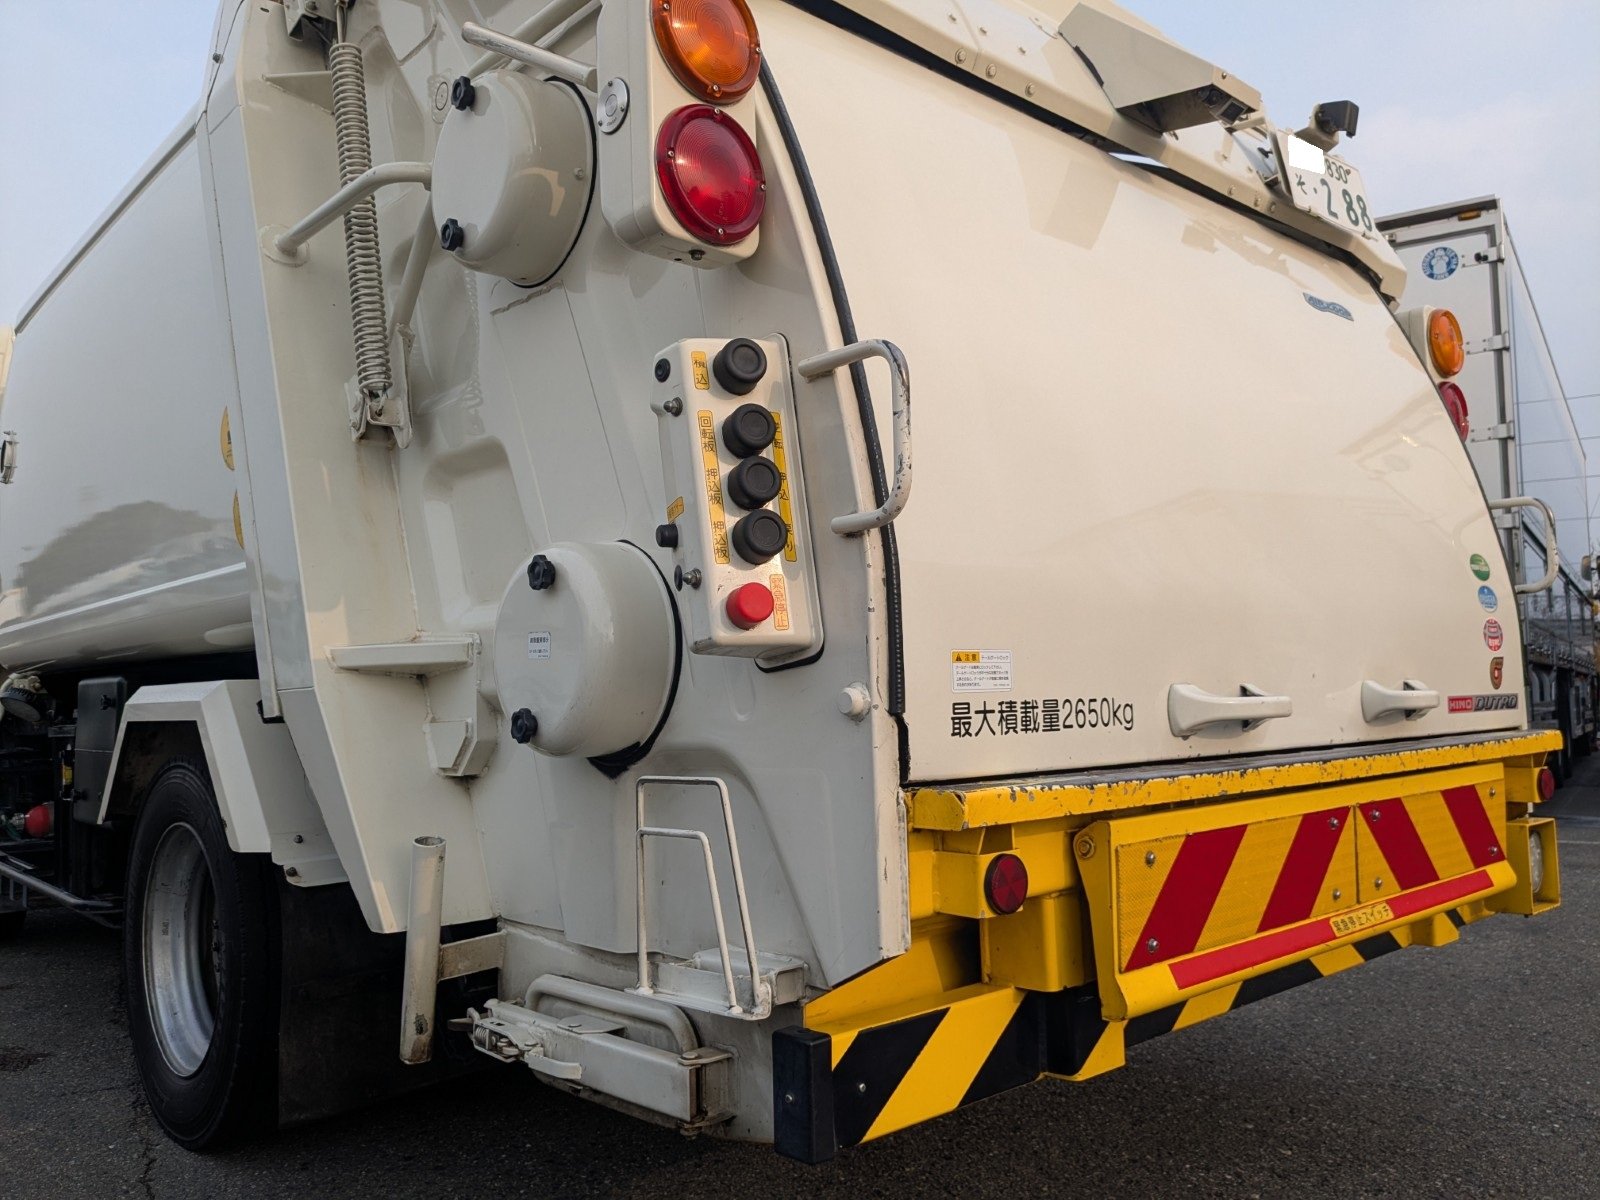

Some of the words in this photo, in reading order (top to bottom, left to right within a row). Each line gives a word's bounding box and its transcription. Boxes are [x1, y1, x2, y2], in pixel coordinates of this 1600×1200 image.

[700, 416, 716, 452] 回転板
[706, 468, 721, 505] 押込板
[713, 521, 729, 558] 押込板
[771, 577, 788, 628] 緊急停止
[950, 697, 1135, 738] 最大積載量2650kg
[1449, 698, 1472, 710] HINO
[1474, 695, 1517, 711] DUTRO
